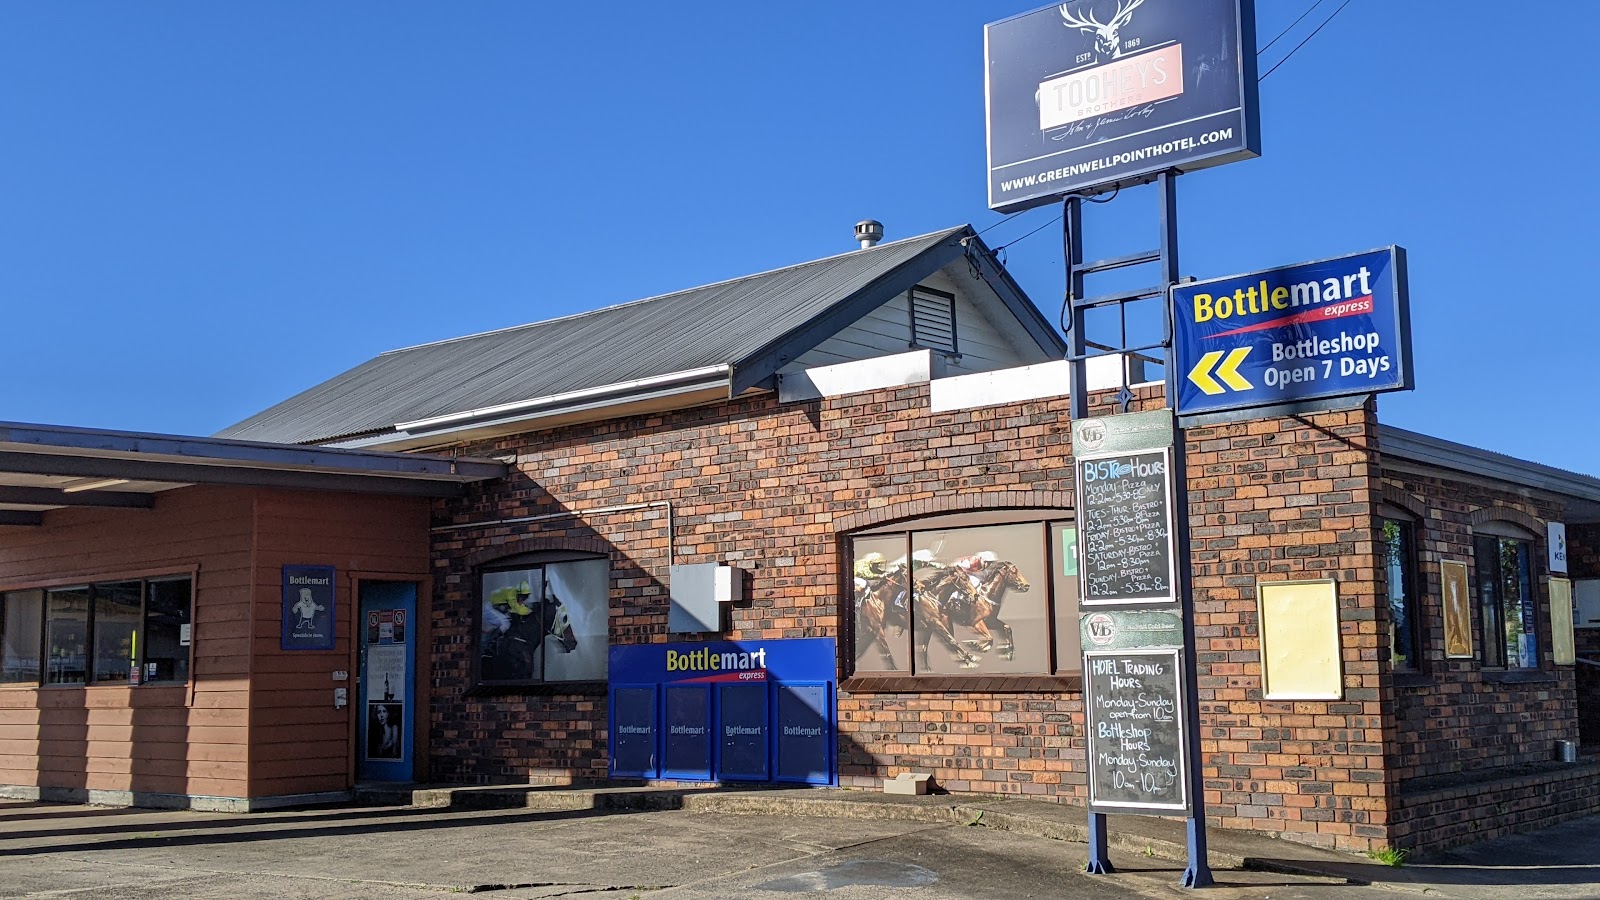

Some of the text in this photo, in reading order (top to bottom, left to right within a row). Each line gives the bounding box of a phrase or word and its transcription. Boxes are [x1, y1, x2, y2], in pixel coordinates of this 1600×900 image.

[1054, 56, 1167, 111] TOOHEYS
[1077, 94, 1142, 117] BROTHERS
[1001, 128, 1233, 192] WWW.GREENWELLPOINTHOTEL.COM
[1194, 266, 1372, 323] Bottlemart
[1324, 300, 1369, 317] express
[1272, 332, 1379, 362] Bottleshop
[1264, 355, 1390, 389] Open 7 Days
[289, 576, 329, 585] Bottlemart
[667, 647, 766, 672] Bottlemart
[1093, 660, 1120, 675] HOTEL
[739, 671, 765, 681] express
[619, 726, 651, 734] Bottlemart
[670, 725, 704, 735] Bottlemart
[725, 726, 761, 735] Bottlemart
[784, 726, 821, 736] Bottlemart
[1099, 722, 1151, 739] Bottleshop
